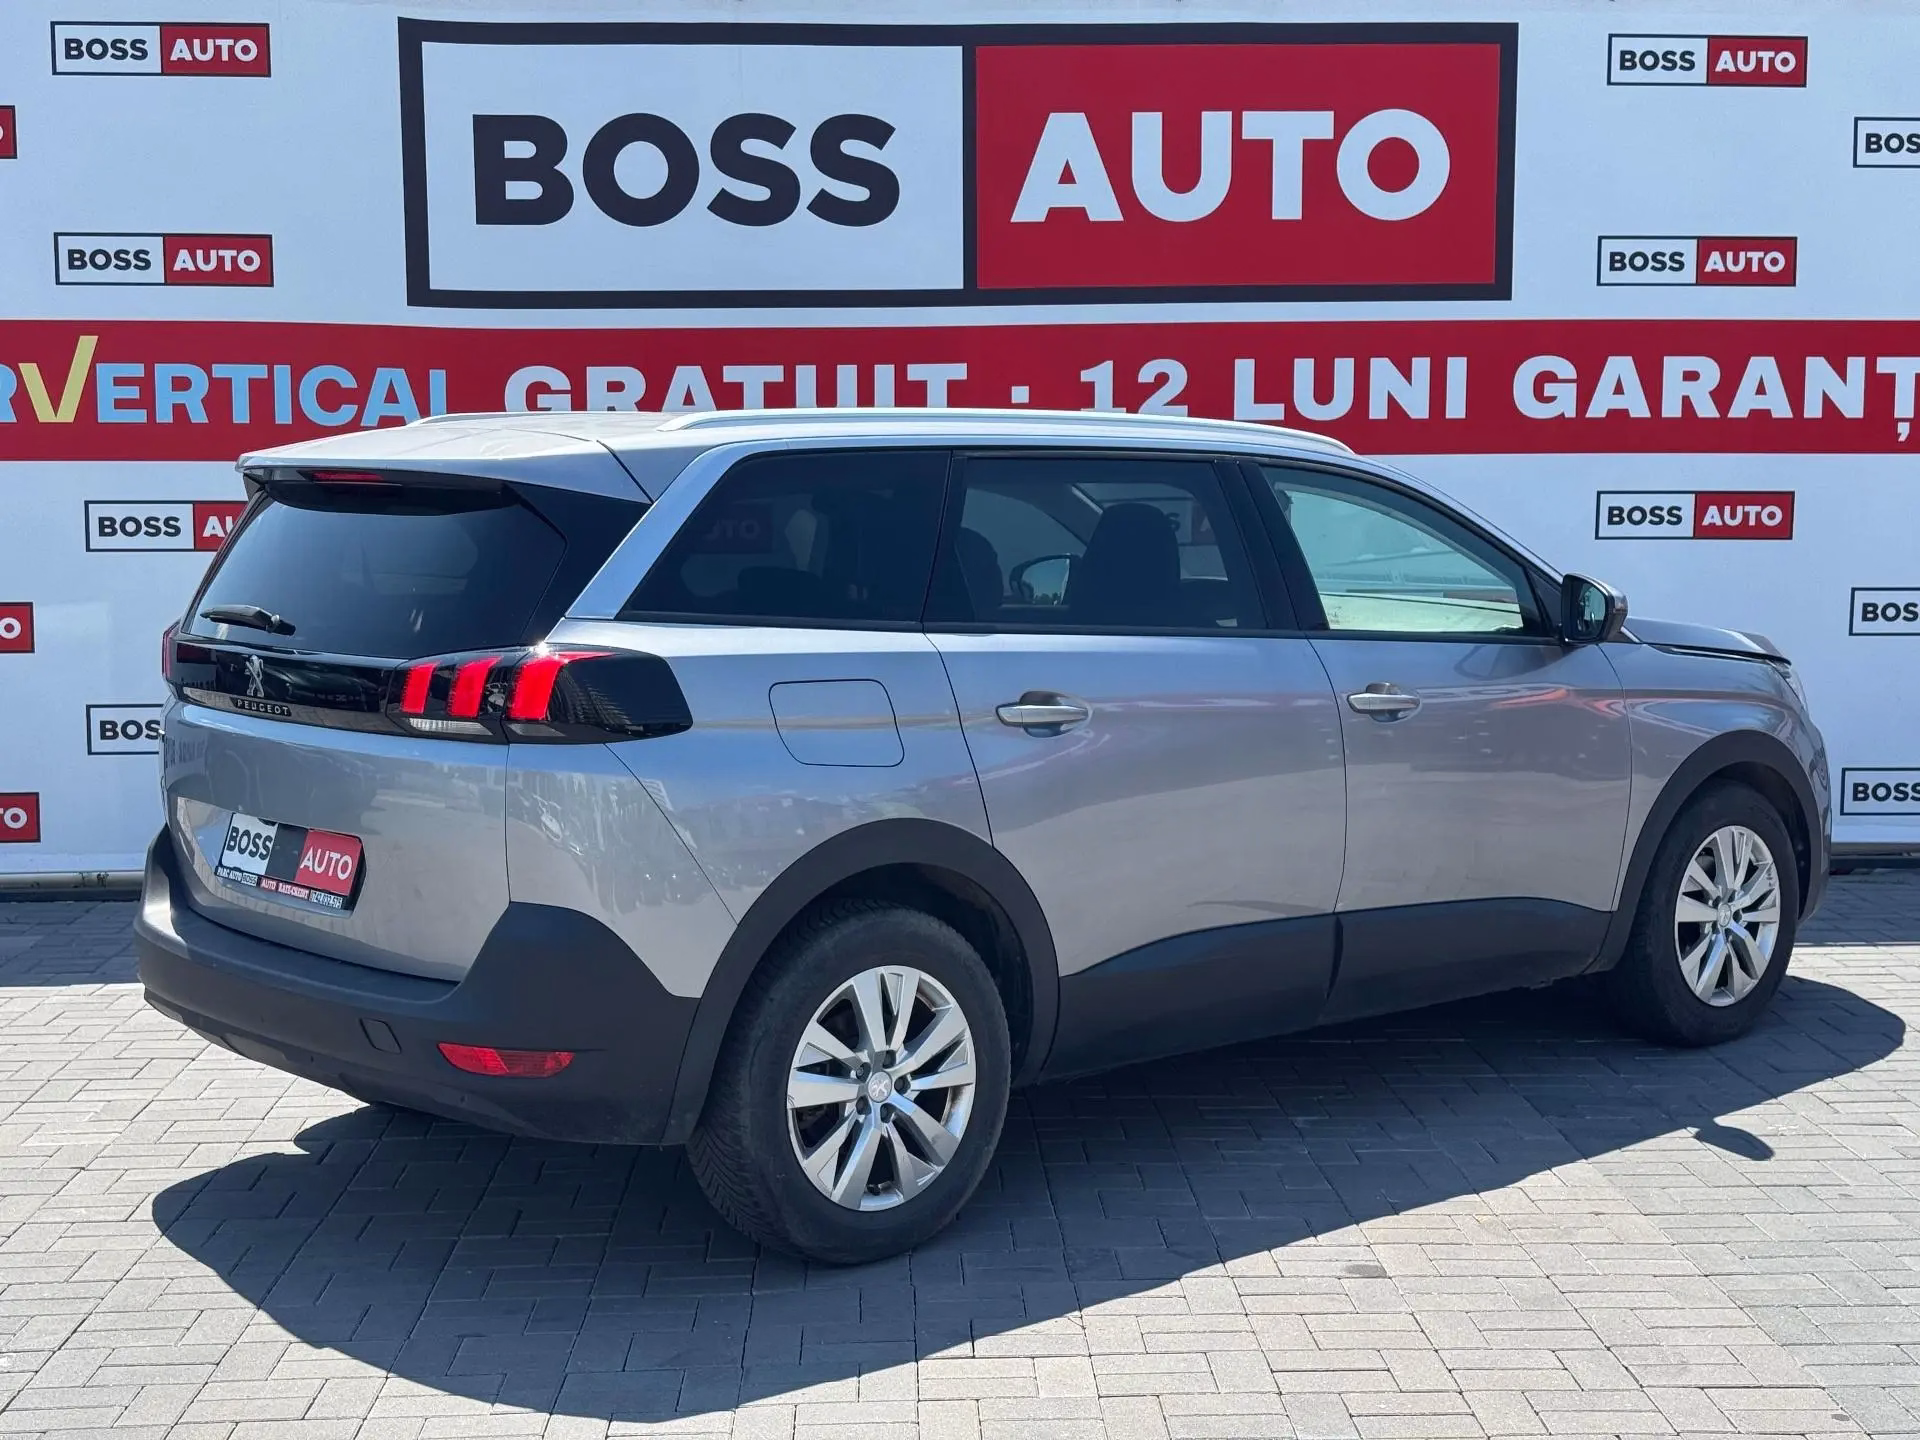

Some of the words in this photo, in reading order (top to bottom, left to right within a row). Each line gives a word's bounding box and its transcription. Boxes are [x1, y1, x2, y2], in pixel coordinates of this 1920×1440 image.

[65, 39, 148, 60] BOSS
[170, 39, 257, 61] AUTO
[1620, 51, 1695, 71] BOSS
[1715, 51, 1796, 72] AUTO
[473, 113, 899, 226] BOSS
[1011, 109, 1450, 222] AUTO
[68, 249, 151, 270] BOSS
[174, 250, 260, 272] AUTO
[1609, 252, 1684, 271] BOSS
[1704, 251, 1785, 272] AUTO
[504, 363, 967, 412] GRATUIT
[1080, 359, 1188, 416] 12
[1234, 357, 1467, 421] LUNI
[98, 516, 181, 537] BOSS
[1607, 506, 1682, 525] BOSS
[1702, 506, 1782, 526] AUTO
[237, 699, 289, 715] PEUGEOT
[225, 826, 273, 860] BOSS
[300, 847, 353, 880] AUTO
